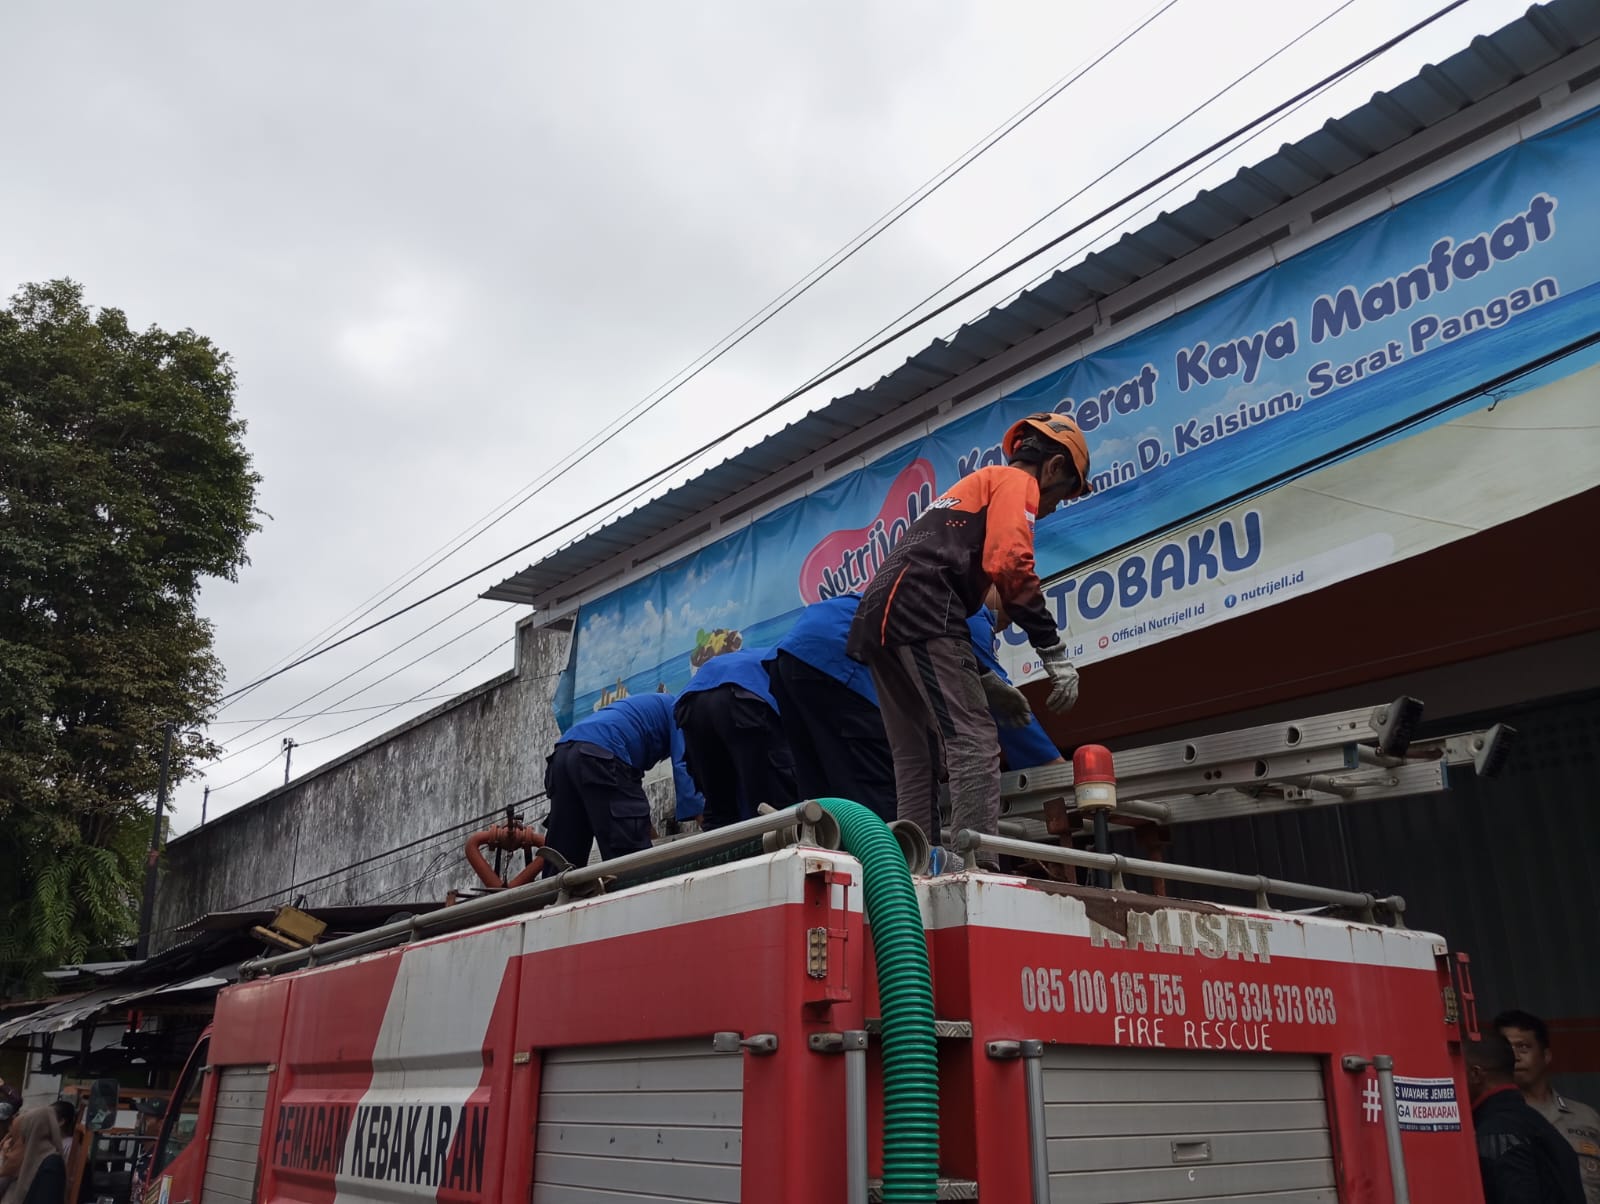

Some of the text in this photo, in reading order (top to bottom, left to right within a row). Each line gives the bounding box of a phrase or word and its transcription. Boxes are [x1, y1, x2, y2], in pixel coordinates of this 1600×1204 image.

[1176, 320, 1296, 392] Kaya
[1311, 196, 1556, 343] Manfaat
[1138, 439, 1170, 472] D,
[1175, 393, 1303, 454] Kalsium,
[1307, 341, 1403, 396] Serat
[1410, 278, 1557, 353] Pangan
[1241, 571, 1304, 602] nutrijell.id
[1112, 623, 1146, 644] Official
[1148, 610, 1192, 632] Nutrijell
[1021, 966, 1337, 1025] 085 100 185 755 085 334 373 833
[1114, 1015, 1273, 1050] FIRE RESCUE
[1401, 1087, 1429, 1100] WAYAHE
[1430, 1088, 1455, 1100] JEMBER
[1412, 1106, 1457, 1119] KEBAKARAN
[273, 1105, 489, 1193] PEMADAM KEBAKARAN
